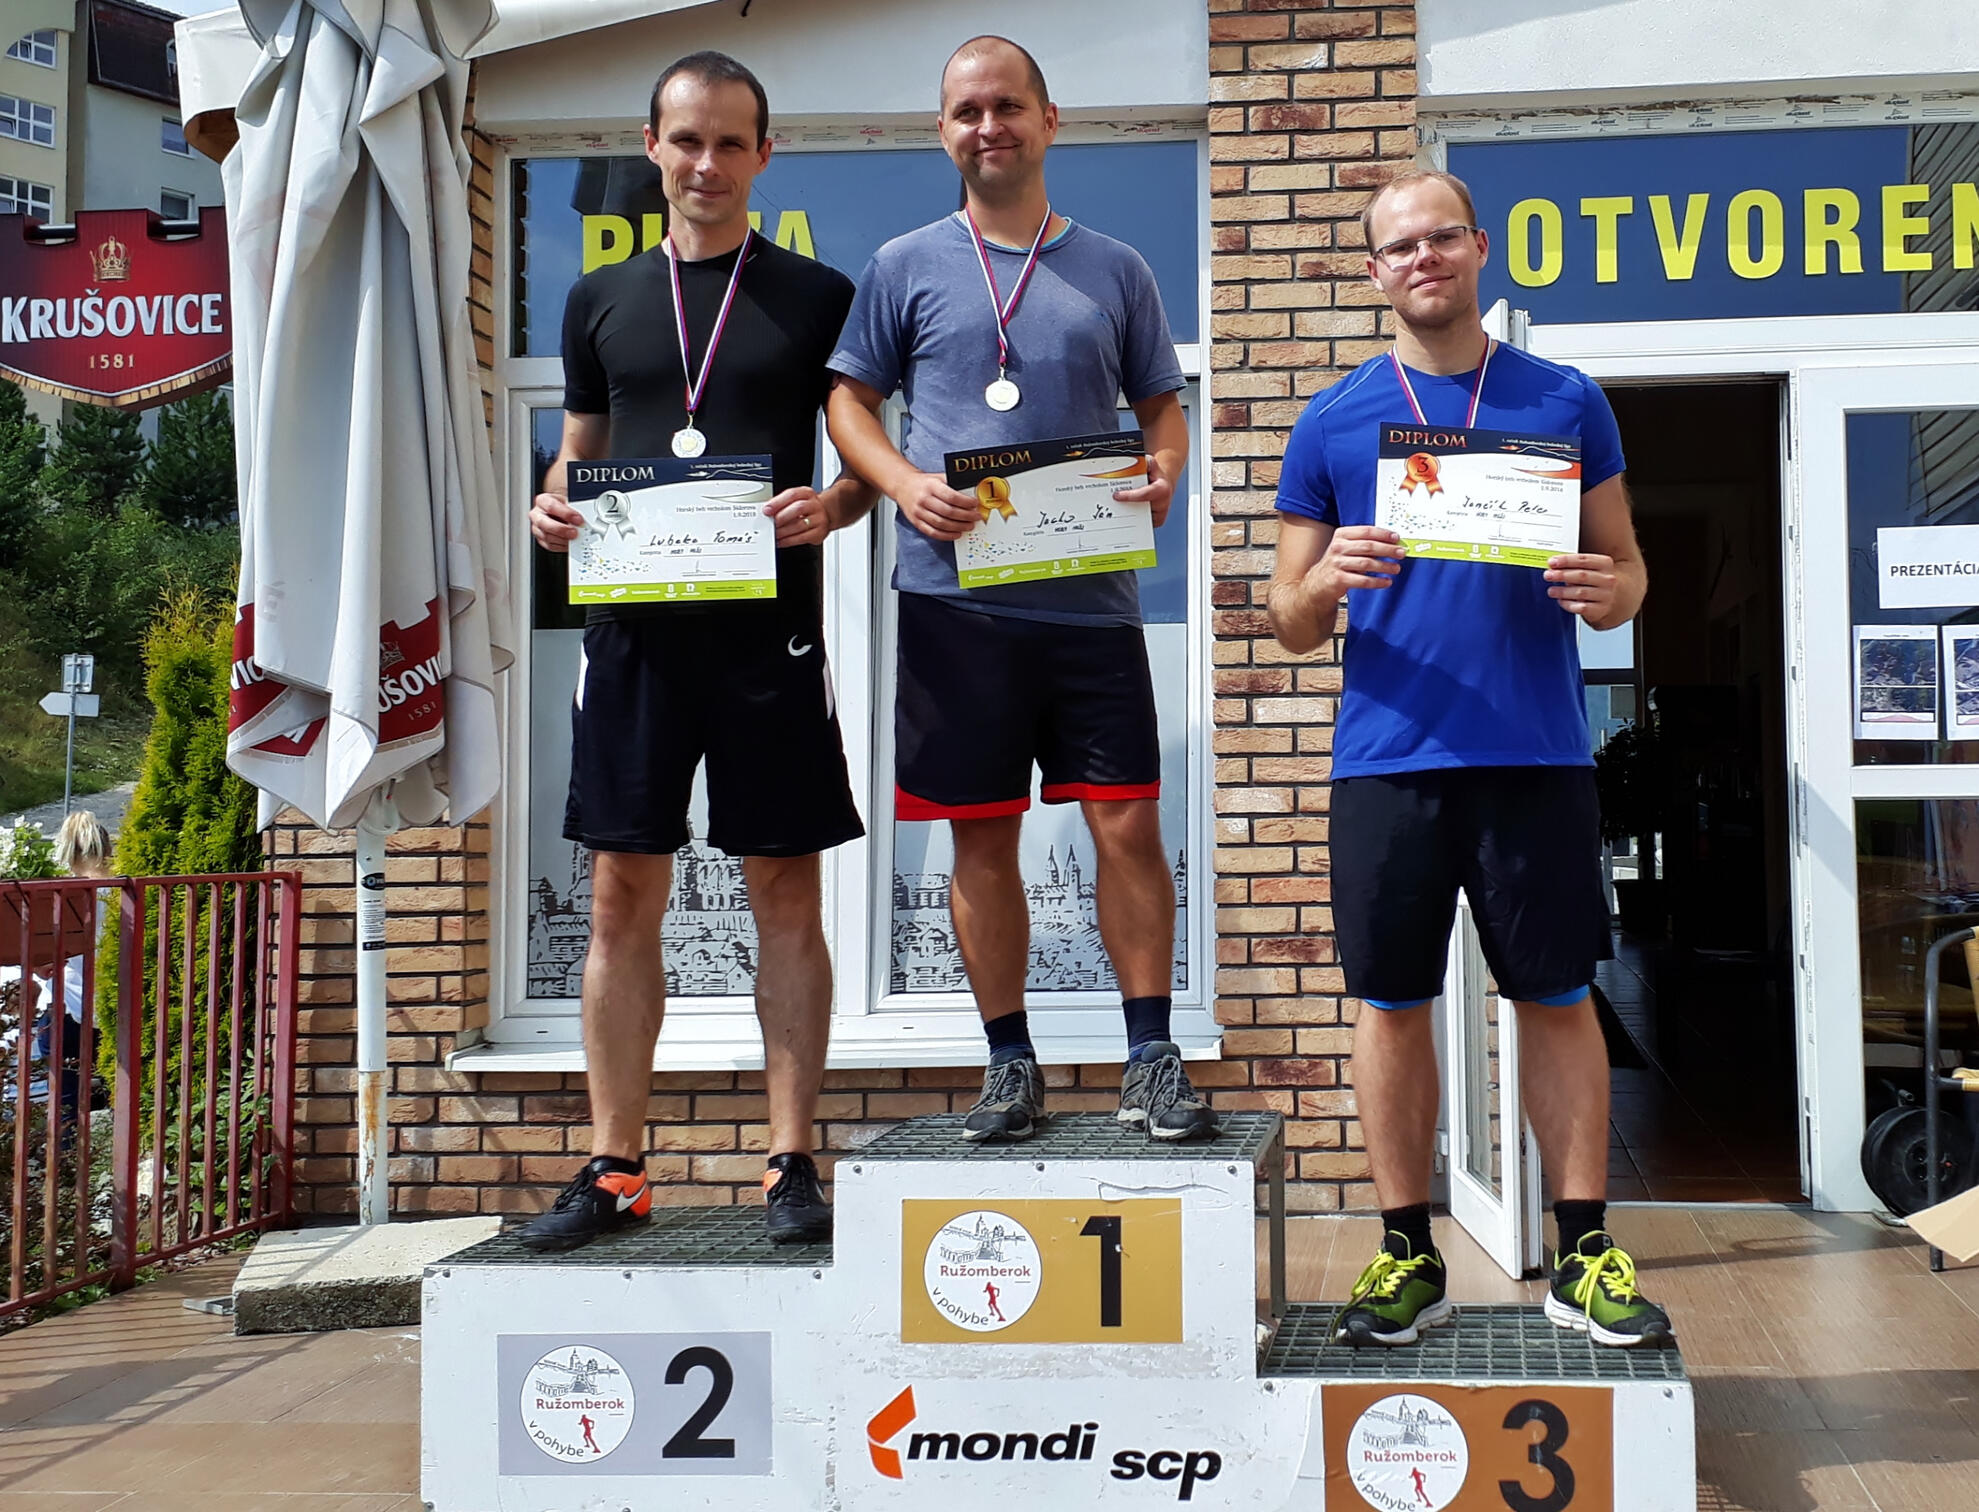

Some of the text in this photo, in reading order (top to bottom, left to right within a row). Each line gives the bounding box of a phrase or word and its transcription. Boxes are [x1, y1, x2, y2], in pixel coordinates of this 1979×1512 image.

[583, 210, 816, 274] PIA
[1, 288, 223, 344] KRUŠOVICE
[89, 353, 135, 370] 1581
[1388, 430, 1467, 448] DIPLOM
[954, 450, 1032, 472] DIPLOM
[1417, 457, 1429, 473] 3
[576, 467, 655, 482] DIPLOM
[987, 481, 997, 498] 1
[607, 494, 618, 513] 2
[1890, 561, 1979, 576] PREZENTÁCI
[940, 1264, 1031, 1278] Ružomberok
[1080, 1216, 1122, 1327] 1
[932, 1287, 989, 1326] v pohybe
[536, 1397, 625, 1410] Ružomberok
[662, 1346, 736, 1458] 2
[529, 1420, 585, 1457] v pohybe
[907, 1422, 1222, 1501] mondi scp
[1363, 1449, 1457, 1463] Ružomberok
[1499, 1399, 1575, 1512] 3
[1362, 1484, 1416, 1512] pohybe
